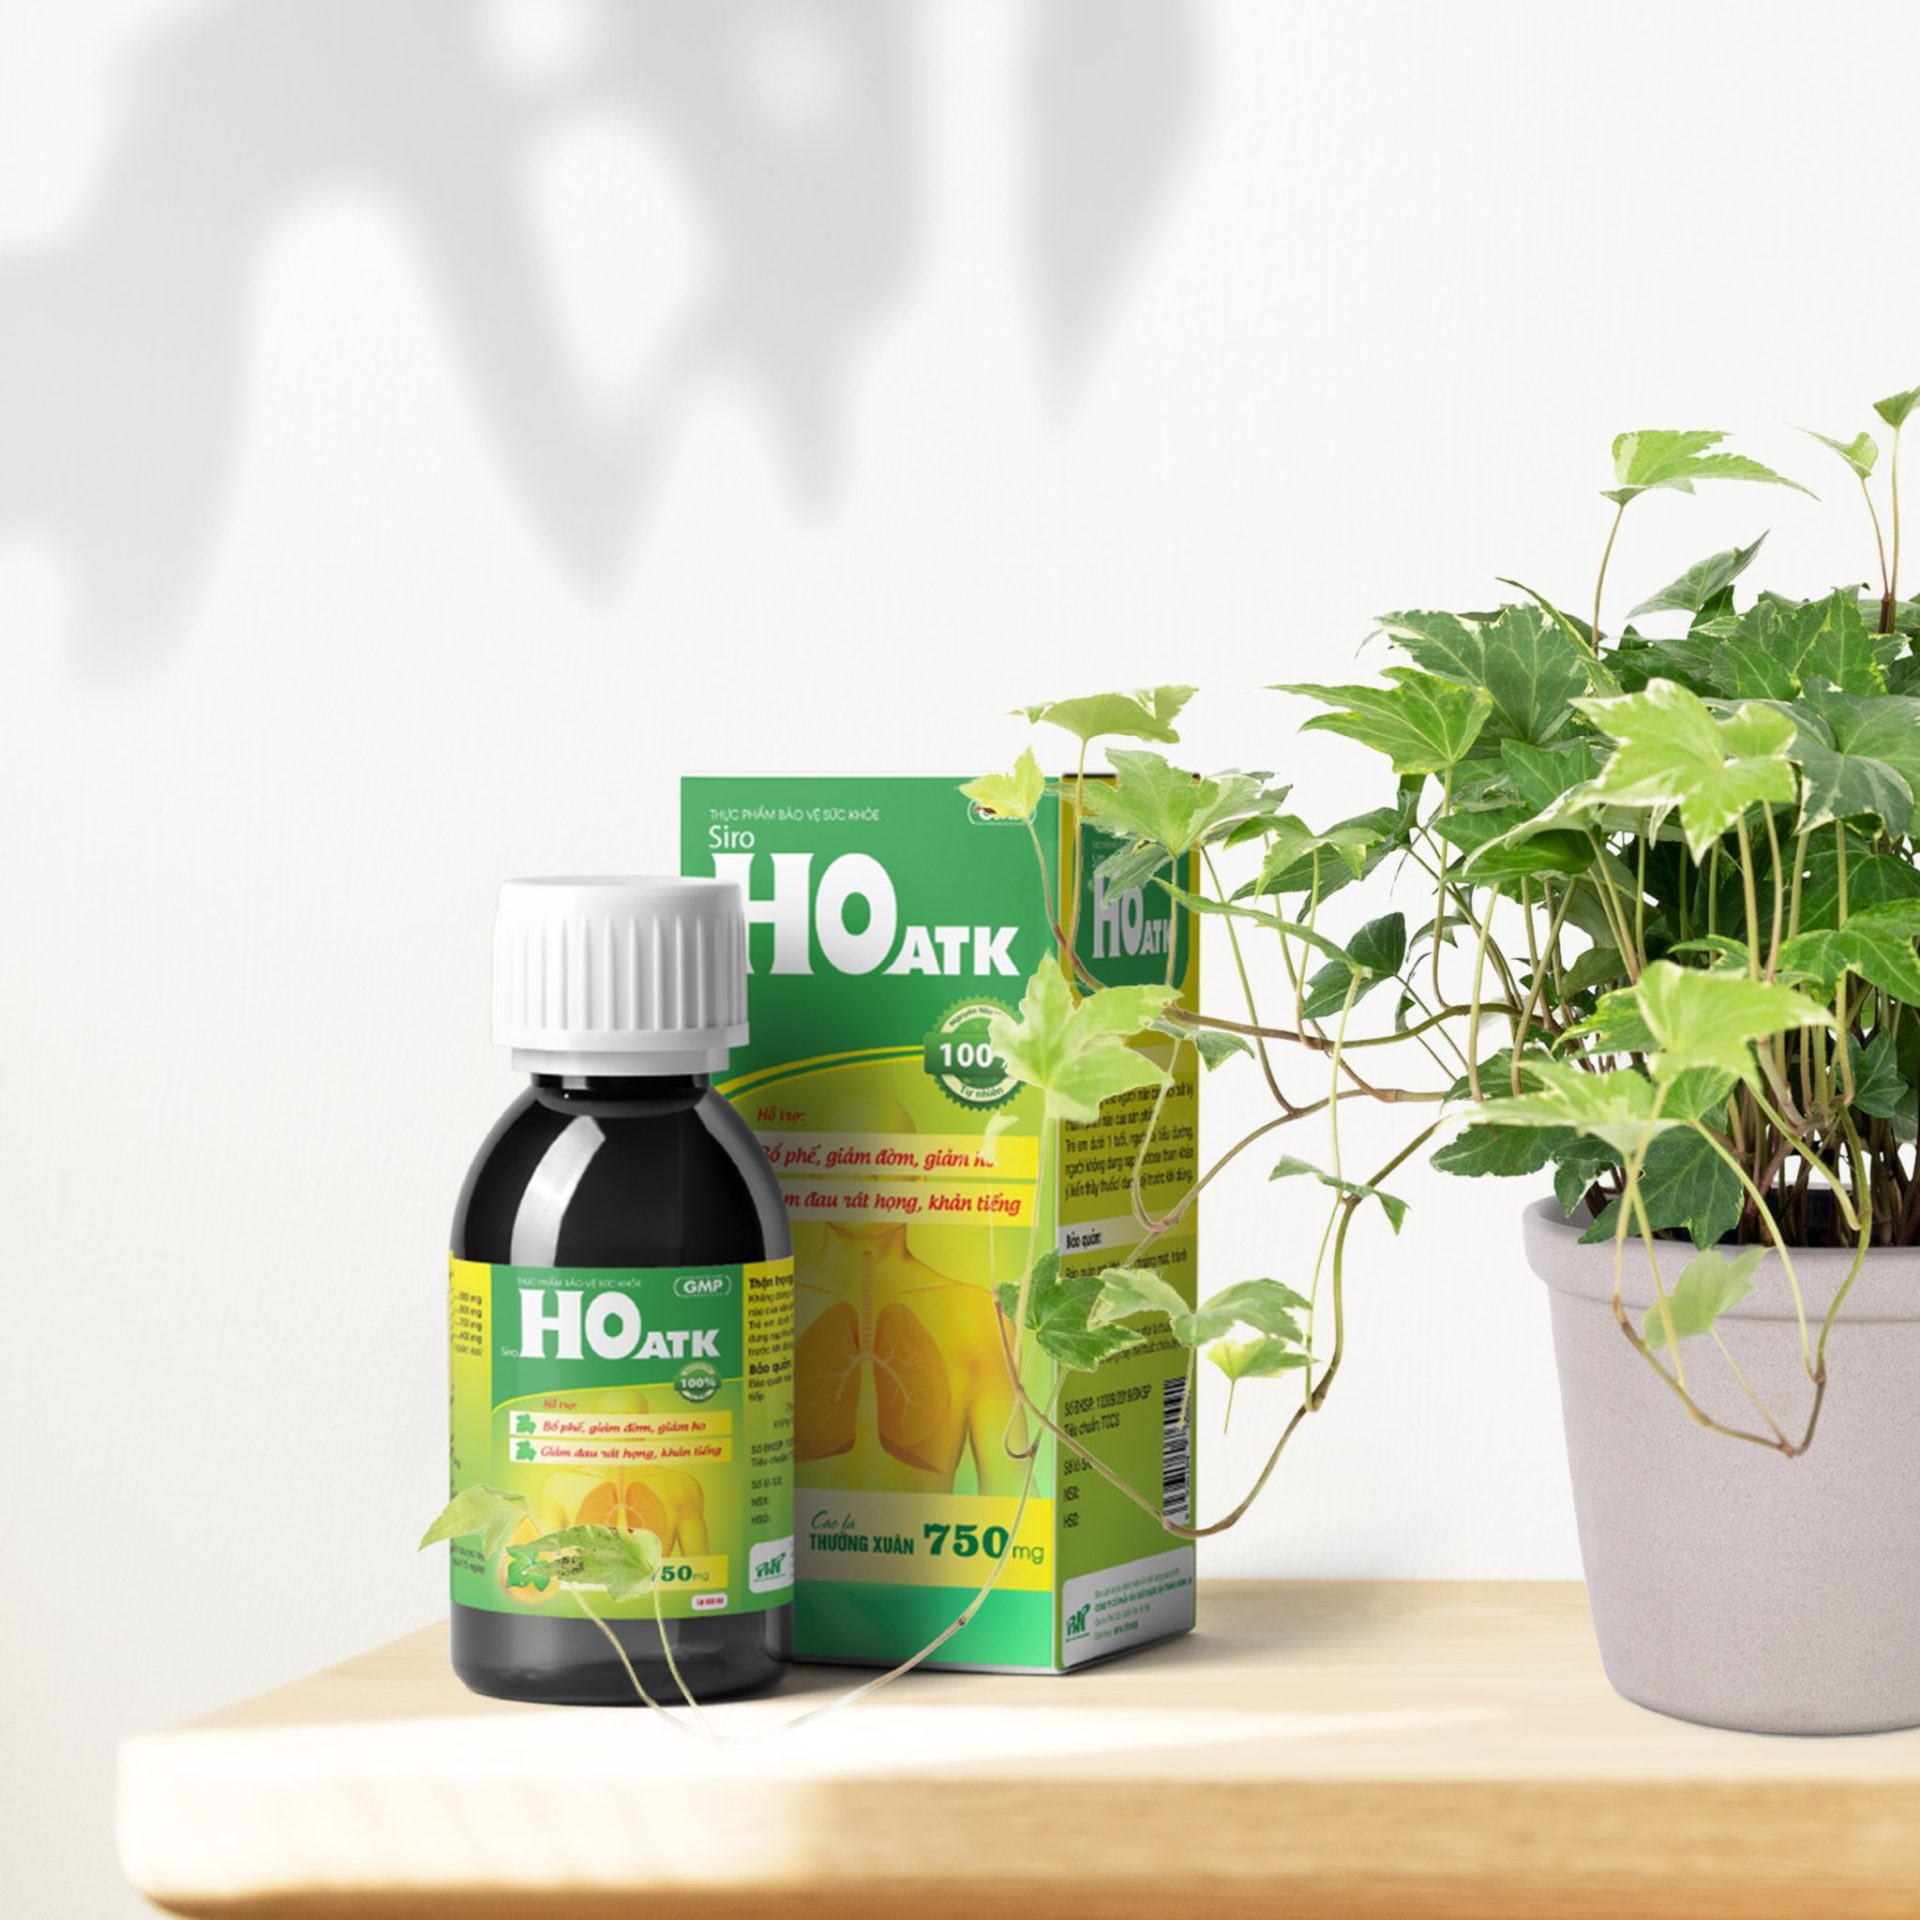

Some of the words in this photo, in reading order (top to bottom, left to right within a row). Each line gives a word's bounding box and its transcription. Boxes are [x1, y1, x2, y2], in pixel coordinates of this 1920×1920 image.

[709, 808, 740, 822] THỰC
[742, 805, 776, 821] PHẨM
[778, 806, 804, 821] BẢO
[805, 809, 821, 822] VỆ
[708, 825, 755, 849] Siro
[940, 1042, 1008, 1068] 100
[756, 1108, 776, 1121] Hỗ
[783, 1145, 821, 1168] phế,
[824, 1146, 871, 1169] giảm
[923, 1149, 969, 1171] giảm
[803, 1190, 838, 1208] đau
[843, 1190, 870, 1209] rát
[873, 1192, 922, 1214] họng,
[928, 1193, 972, 1211] khản
[976, 1192, 1022, 1217] tiếng
[683, 1278, 723, 1294] GMP
[680, 1377, 717, 1389] 100%
[809, 1531, 869, 1553] THƯỜNG
[872, 1533, 915, 1555] XUÂN
[923, 1522, 1010, 1559] 750
[1012, 1545, 1045, 1566] mg
[653, 1565, 692, 1582] 50
